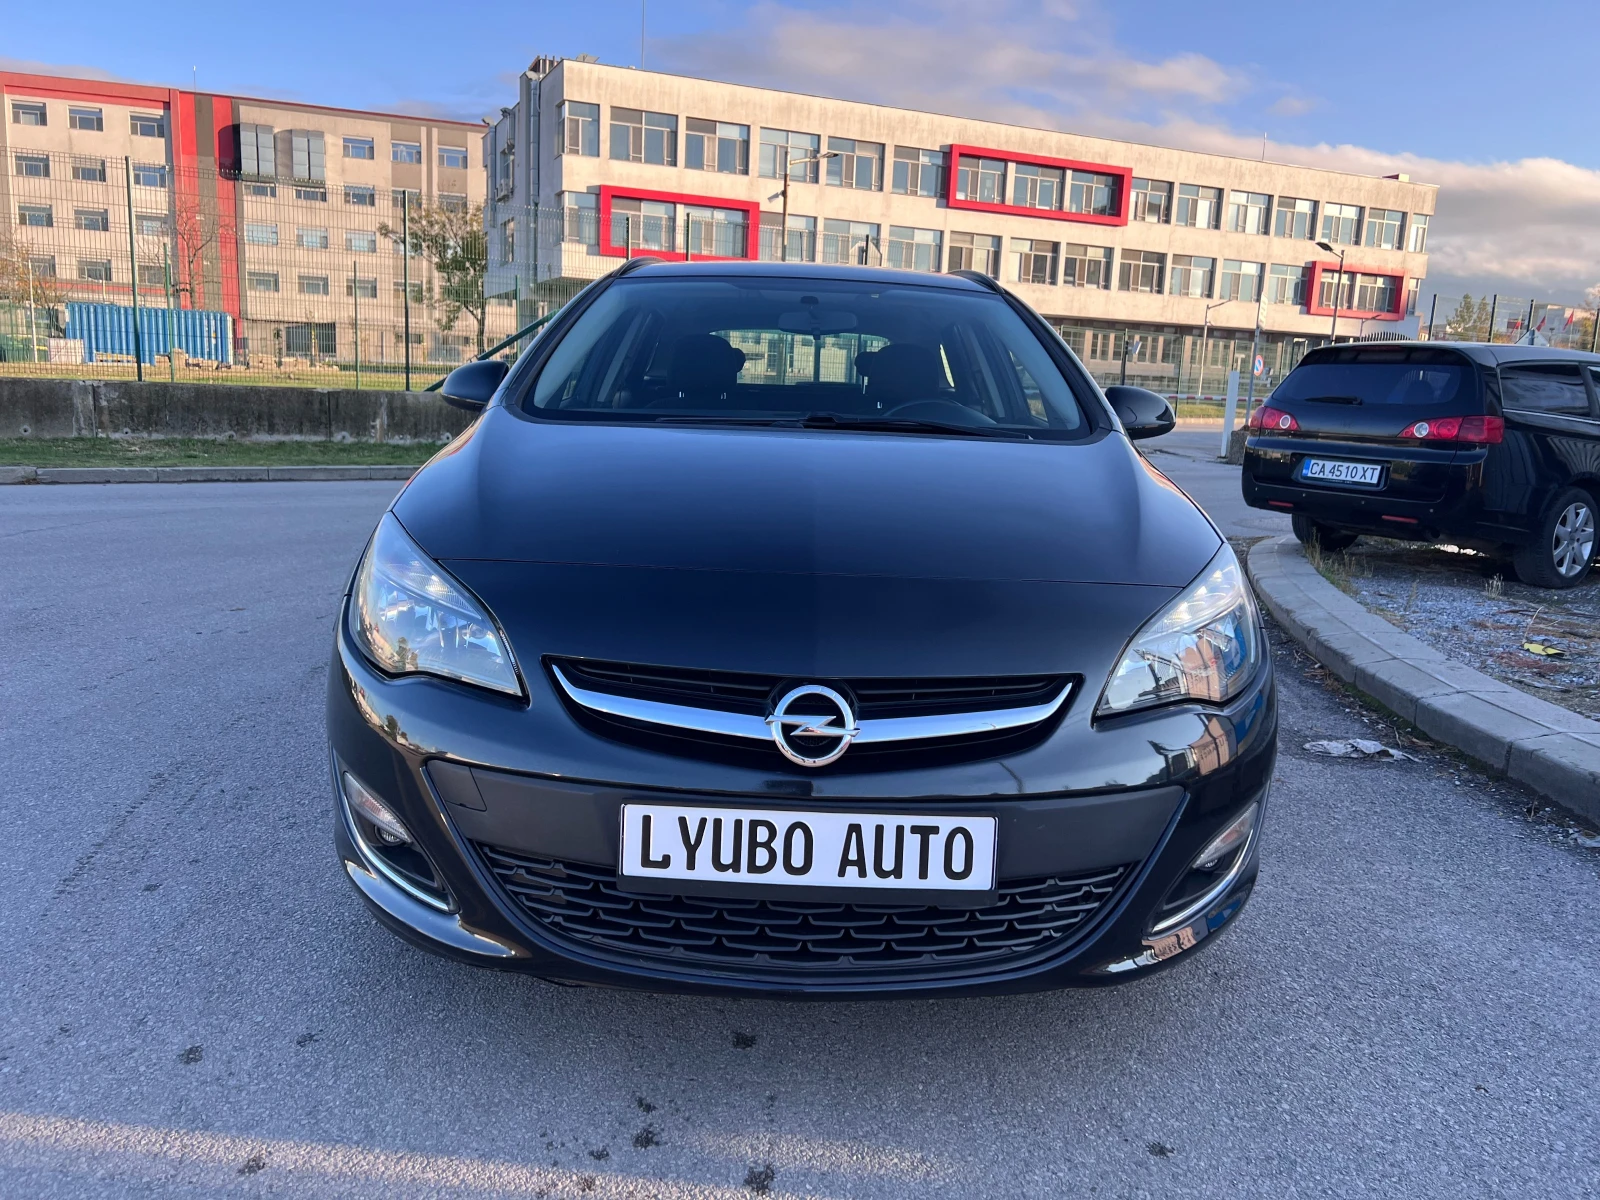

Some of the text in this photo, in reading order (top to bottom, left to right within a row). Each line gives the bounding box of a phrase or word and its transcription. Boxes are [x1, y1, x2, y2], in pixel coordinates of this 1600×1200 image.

[1310, 462, 1378, 481] CA 4510 XT
[641, 814, 974, 880] LYUBO AUTO
